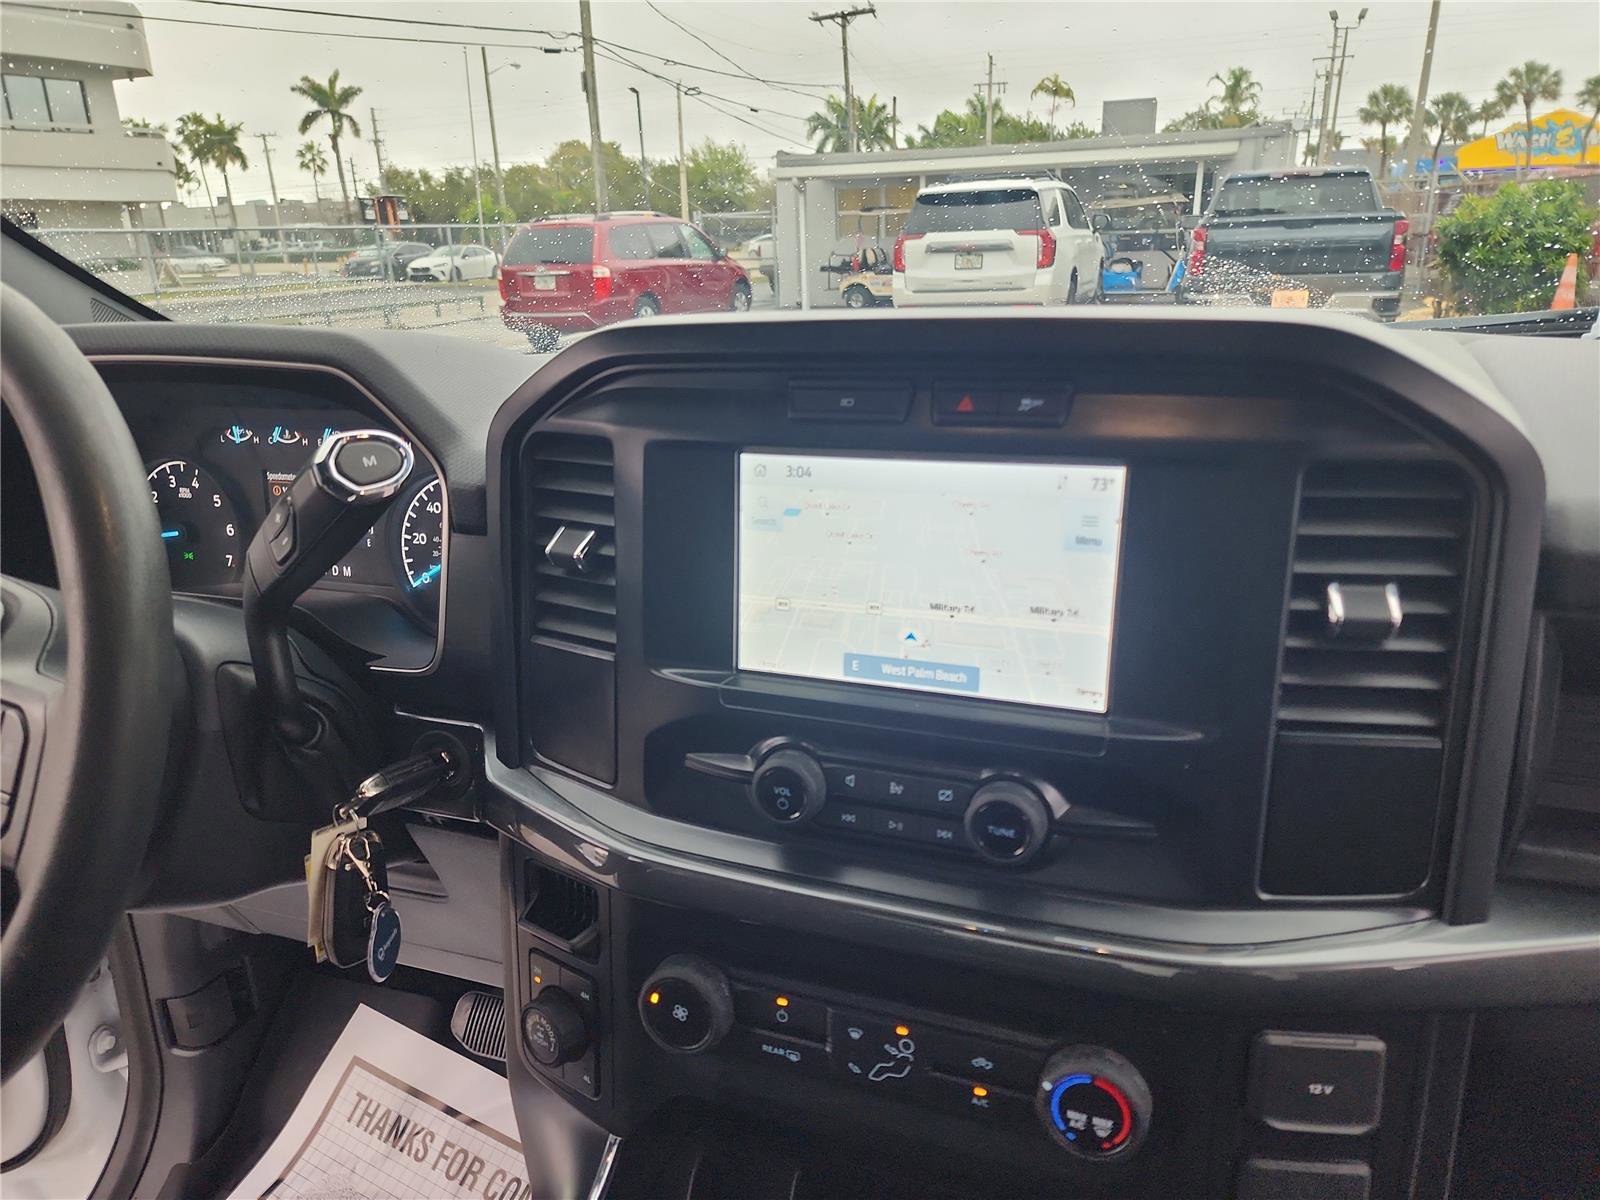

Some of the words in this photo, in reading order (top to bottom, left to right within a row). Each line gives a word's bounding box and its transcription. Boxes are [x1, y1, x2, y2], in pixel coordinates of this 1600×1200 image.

[362, 455, 378, 467] M
[785, 464, 812, 478] 3:04
[168, 475, 176, 488] 3
[191, 477, 200, 489] 4
[151, 491, 159, 503] 2
[213, 494, 221, 507] 5
[426, 502, 441, 514] 40
[226, 524, 235, 536] 6
[412, 533, 427, 545] 20
[225, 554, 233, 567] 7
[331, 566, 339, 576] D
[343, 567, 352, 577] M
[851, 660, 860, 671] E
[881, 663, 905, 677] West
[907, 666, 934, 680] Palm
[935, 669, 967, 683] Beach
[773, 786, 792, 797] VOL
[988, 825, 1016, 839] TUNE
[346, 1092, 436, 1163] THANKS
[431, 1140, 486, 1192] FOR
